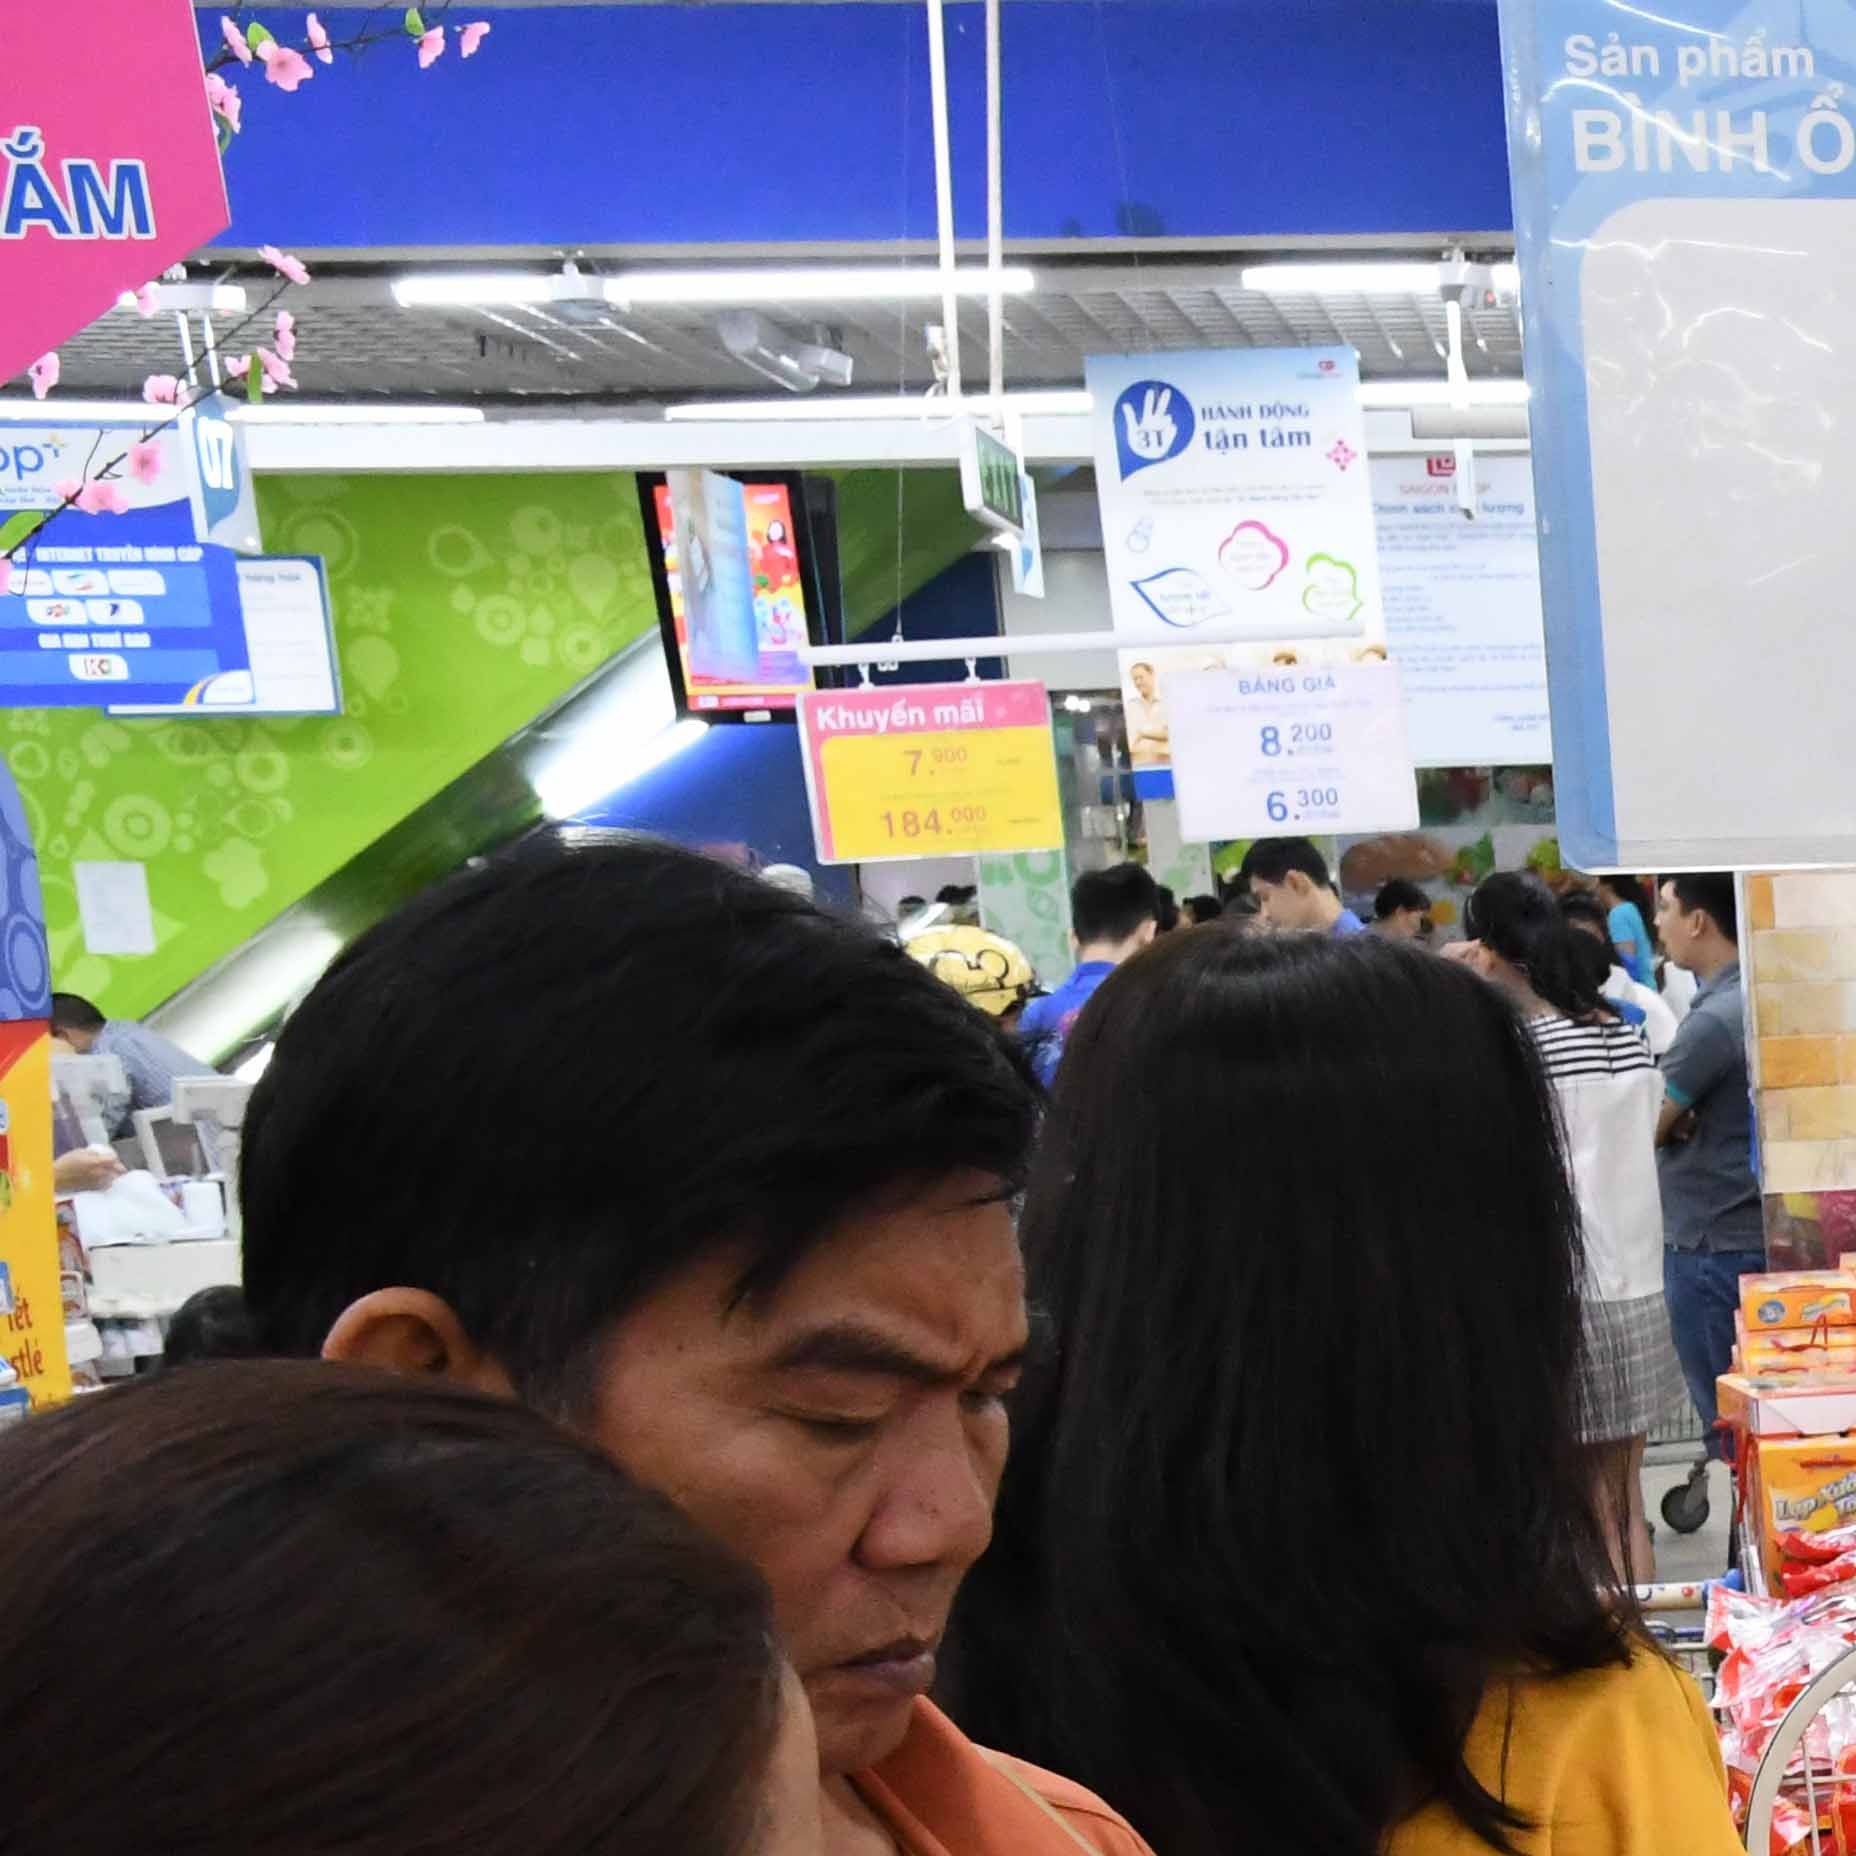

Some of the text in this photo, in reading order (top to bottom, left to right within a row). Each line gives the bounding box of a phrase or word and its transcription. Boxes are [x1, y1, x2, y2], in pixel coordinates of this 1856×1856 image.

[1564, 28, 1816, 88] Sản phẩm
[1572, 92, 1770, 174] BÌNH
[1137, 429, 1166, 449] 3T
[1259, 427, 1312, 449] tâm
[817, 697, 985, 734] Khuyến mãi
[1259, 723, 1333, 758] 8.200
[1266, 788, 1339, 823] 6.300
